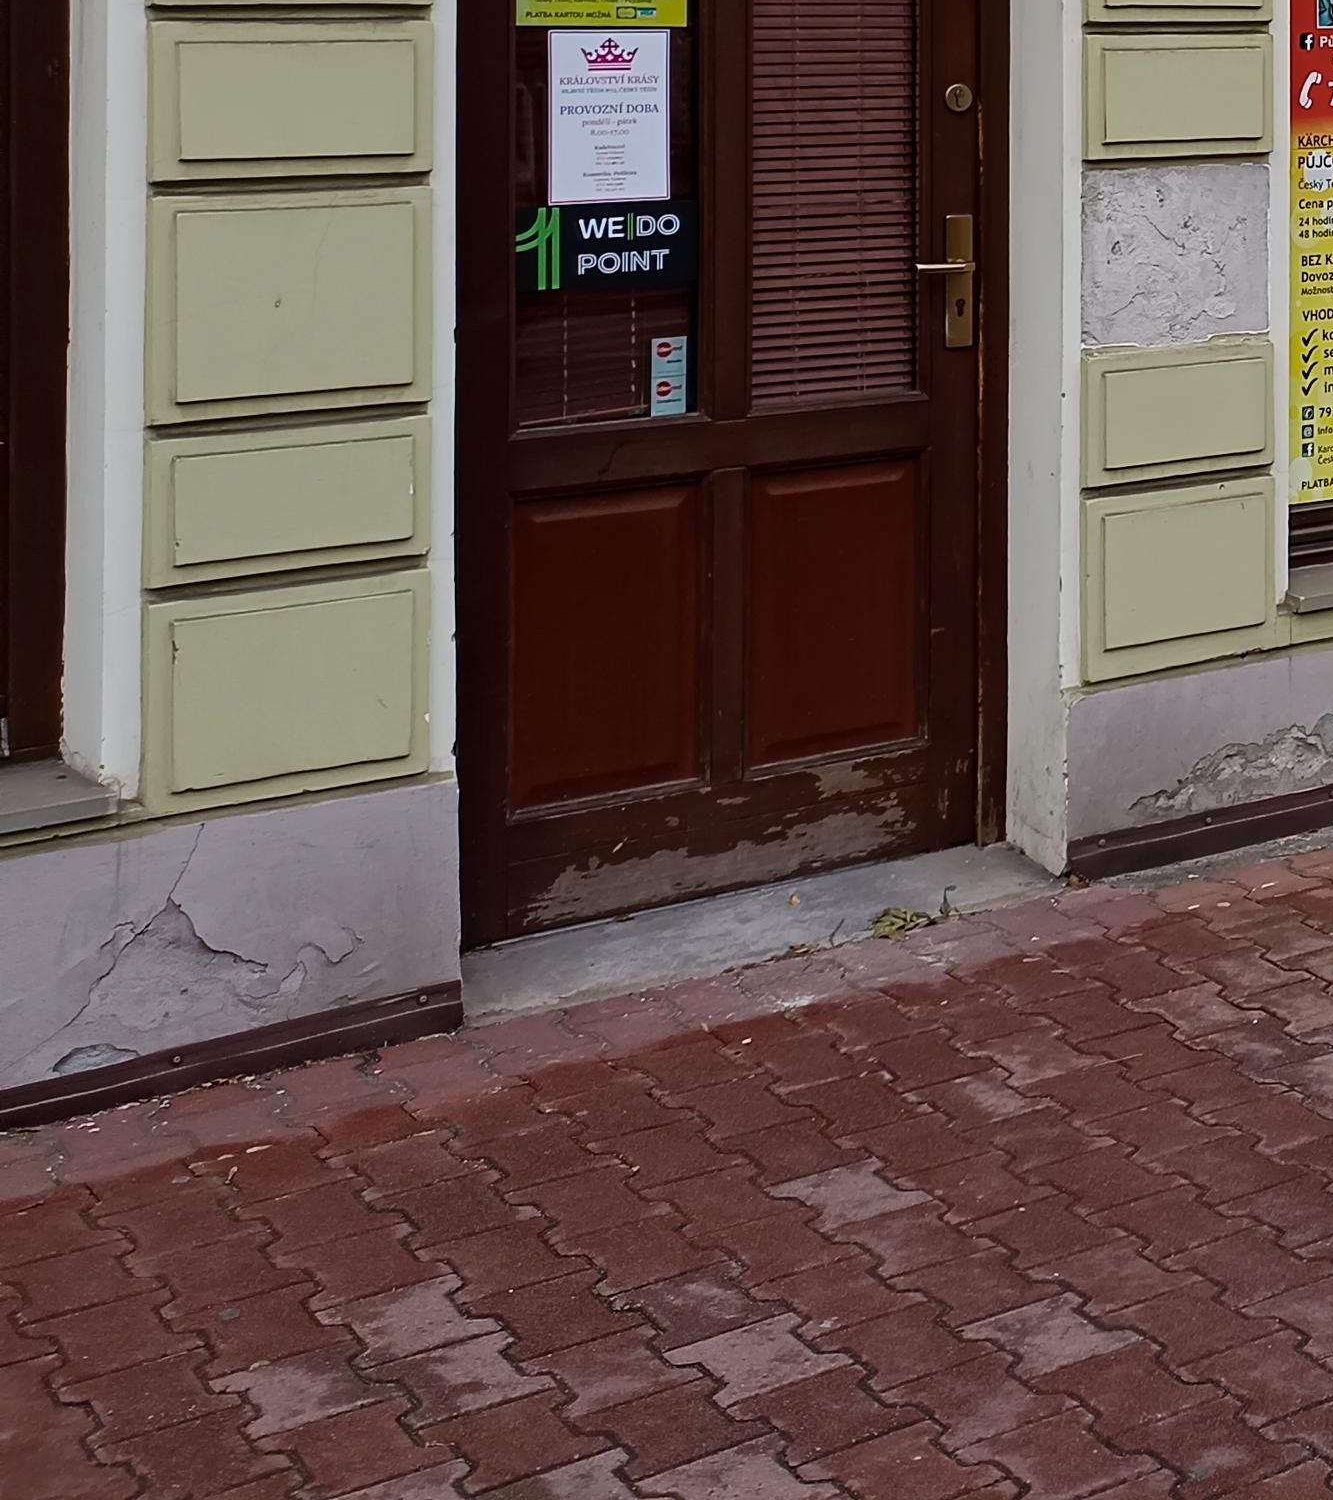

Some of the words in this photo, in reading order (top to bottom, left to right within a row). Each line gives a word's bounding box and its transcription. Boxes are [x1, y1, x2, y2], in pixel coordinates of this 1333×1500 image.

[560, 74, 625, 85] KRÁLOVSTVÍ
[628, 75, 659, 83] KRÁSY
[560, 102, 623, 115] PROVOZNÍ
[627, 104, 659, 113] DOBA
[1299, 199, 1323, 209] Cena
[577, 249, 669, 275] POINT
[1301, 255, 1321, 266] BEZ
[1301, 284, 1333, 295] Možnost
